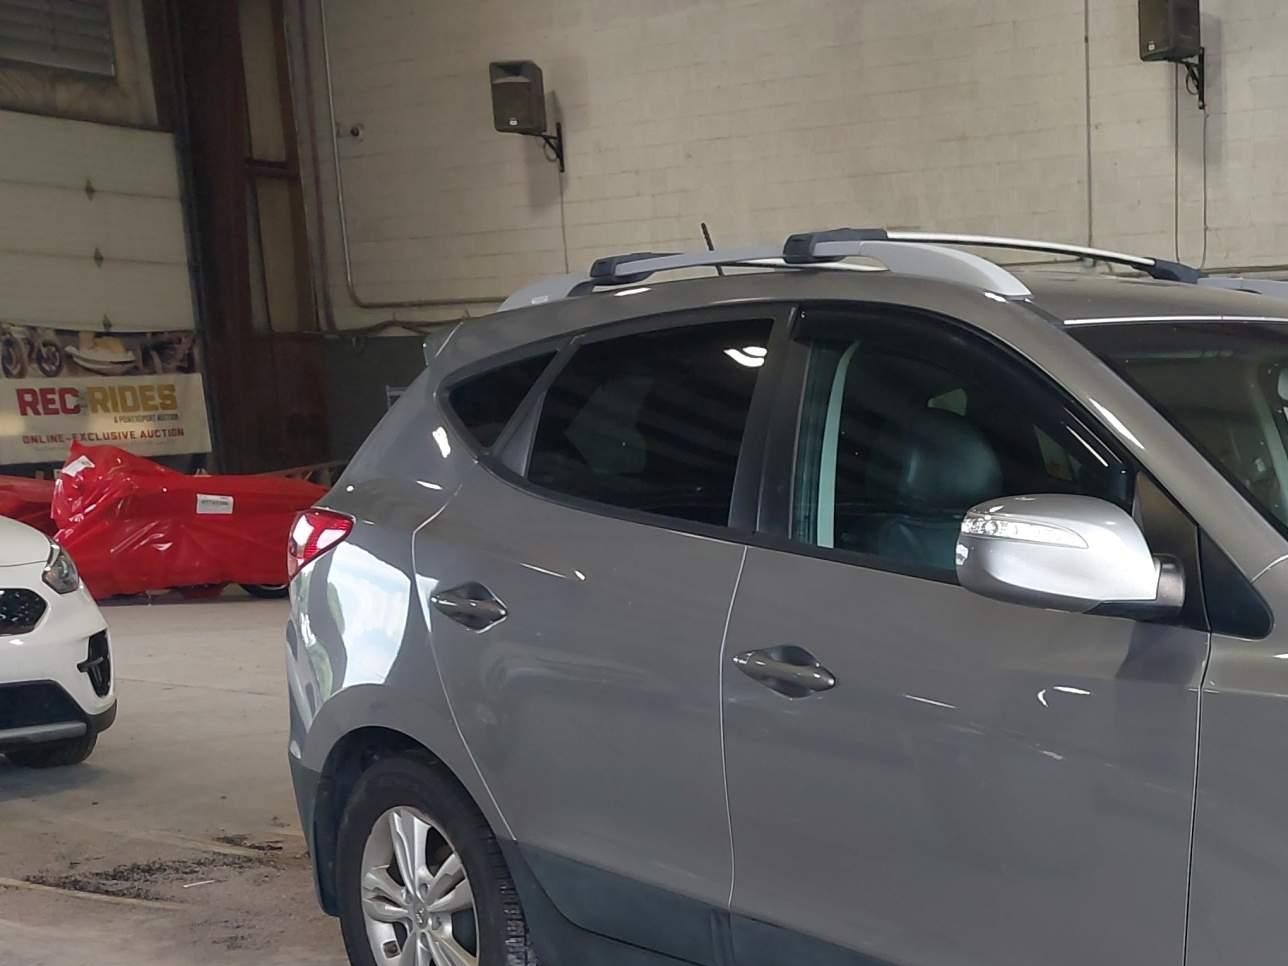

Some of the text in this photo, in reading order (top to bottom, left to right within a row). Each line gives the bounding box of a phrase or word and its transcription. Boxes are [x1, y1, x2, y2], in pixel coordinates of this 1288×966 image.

[16, 383, 177, 416] REC RIDES
[140, 428, 185, 438] AUCTION
